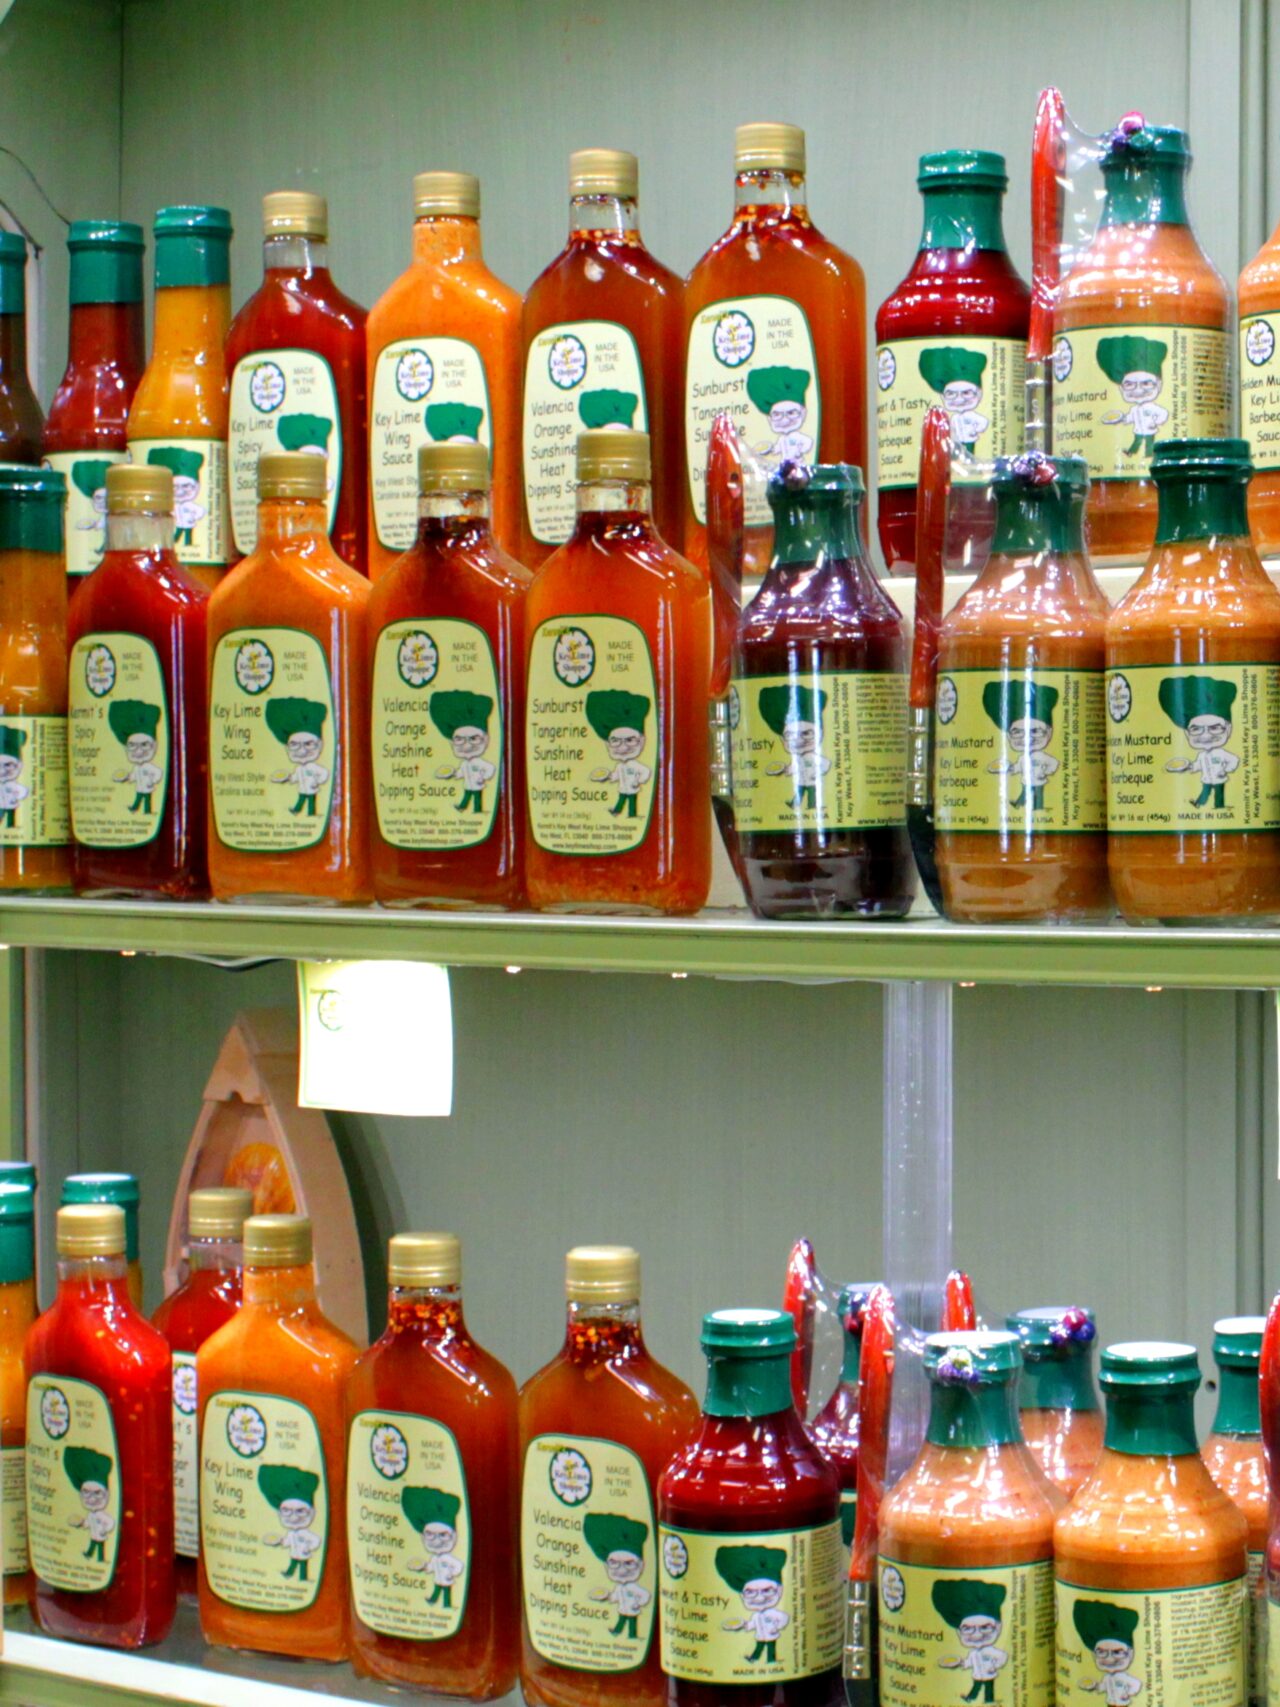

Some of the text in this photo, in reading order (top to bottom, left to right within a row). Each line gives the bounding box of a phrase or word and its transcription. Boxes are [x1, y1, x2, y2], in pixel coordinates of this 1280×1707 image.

[768, 318, 792, 328] MADE
[777, 329, 793, 338] THE
[771, 340, 789, 348] USA
[693, 378, 745, 398] Sunburst
[1067, 390, 1107, 402] Mustard
[1251, 394, 1266, 408] Key
[532, 402, 573, 416] Valencia
[249, 417, 273, 430] Lime
[376, 411, 420, 429] Key Lime
[534, 423, 572, 439] Orange
[384, 434, 411, 450] Wing
[382, 452, 412, 465] Sauce
[540, 463, 565, 477] Heat
[528, 484, 561, 501] Dipping
[453, 642, 476, 650] MADE
[608, 641, 632, 649] MADE
[462, 654, 478, 662] THE
[611, 664, 629, 672] USA
[214, 703, 261, 719] Key Lime
[383, 698, 429, 712] Valencia
[532, 698, 584, 714] Sunburst
[224, 725, 251, 744] Wing
[386, 721, 426, 740] Orange
[532, 723, 587, 744] Tangerine
[746, 739, 774, 753] Tasty
[951, 736, 993, 748] Mustard
[1125, 733, 1171, 746] Mustard
[222, 746, 253, 760] Sauce
[383, 744, 432, 758] Sunshine
[533, 746, 584, 761] Sunshine
[1128, 752, 1153, 765] Lime
[392, 763, 419, 777] Heat
[954, 757, 978, 769] Lime
[545, 767, 571, 781] Heat
[380, 783, 455, 801] Dipping Sauce
[532, 787, 608, 805] Dipping Sauce
[1117, 792, 1144, 804] Sauce
[205, 1459, 253, 1480] Key Lime
[606, 1466, 630, 1475] MADE
[215, 1481, 243, 1501] Wing
[357, 1482, 400, 1503] Valencia
[213, 1500, 246, 1519] Sauce
[361, 1506, 398, 1528] Orange
[534, 1510, 581, 1532] Valencia
[358, 1529, 404, 1549] Sunshine
[536, 1533, 580, 1555] Orange
[366, 1549, 392, 1566] Heat
[534, 1556, 585, 1578] Sunshine
[355, 1564, 426, 1590] Dipping Sauce
[544, 1579, 572, 1595] Heat
[530, 1594, 610, 1620] Dipping Sauce
[693, 1592, 729, 1610] Tasty
[681, 1608, 707, 1622] Lime
[898, 1624, 943, 1641] Mustard
[901, 1642, 925, 1657] Lime
